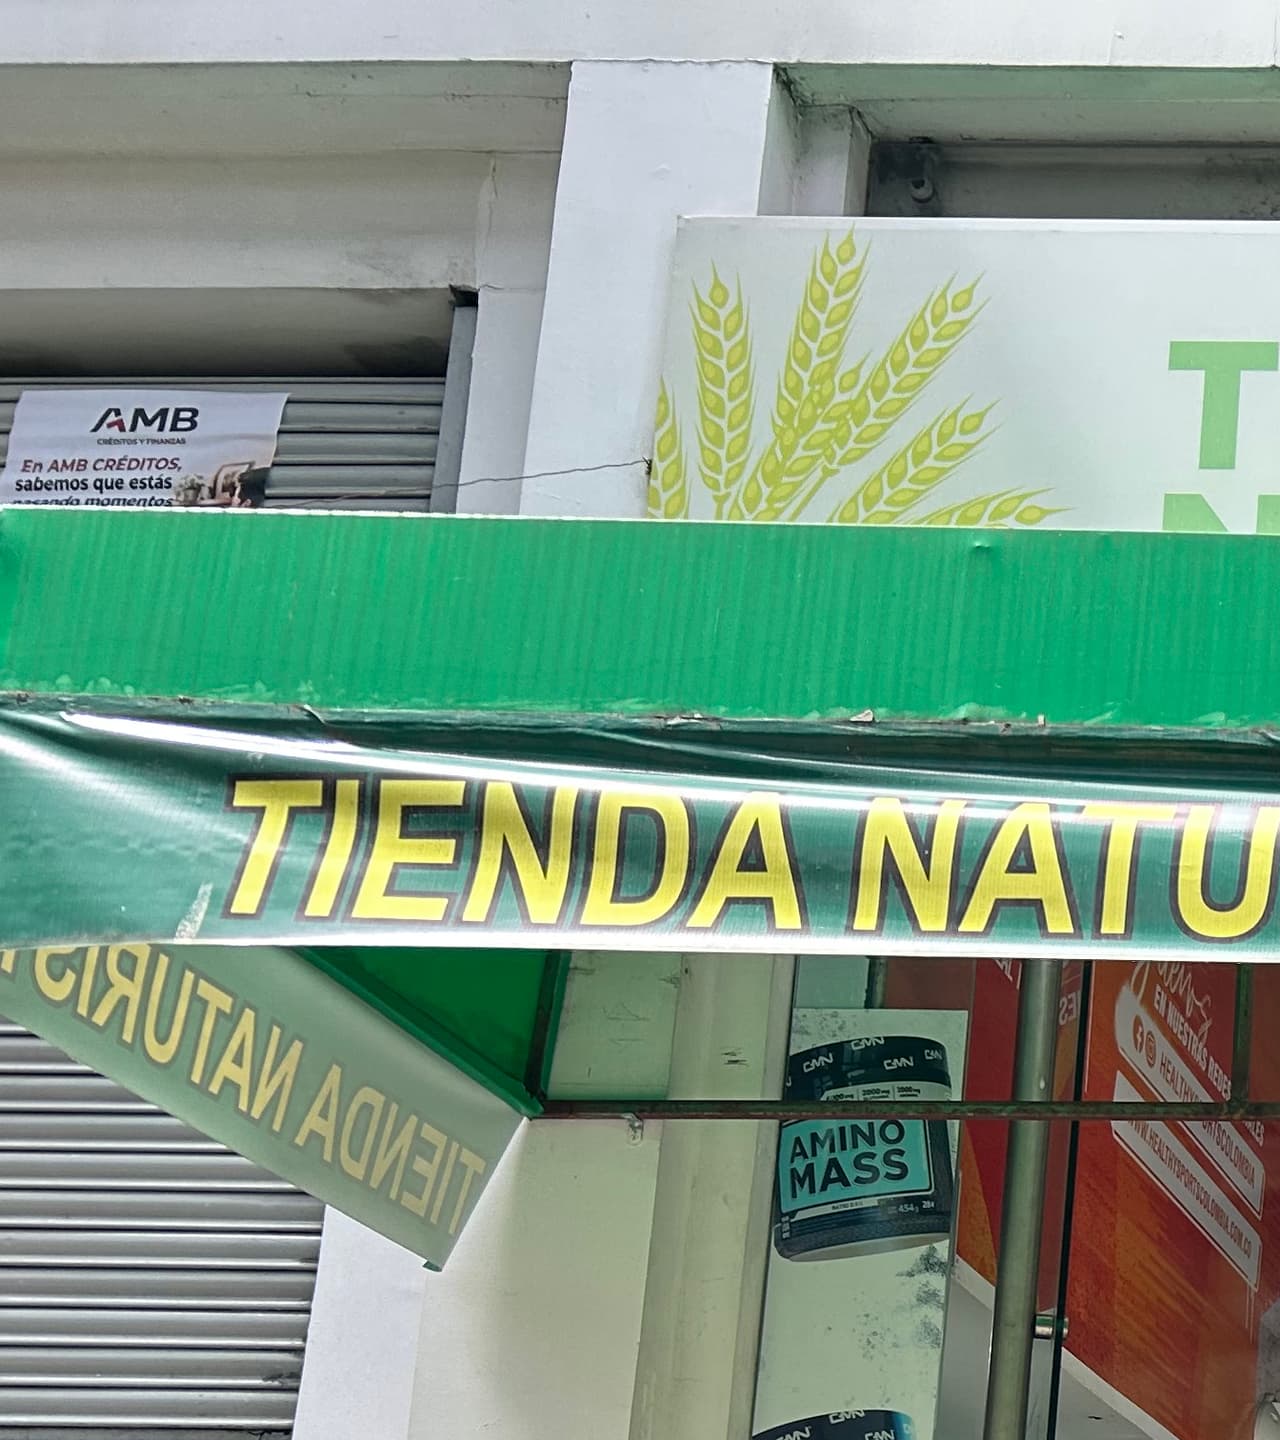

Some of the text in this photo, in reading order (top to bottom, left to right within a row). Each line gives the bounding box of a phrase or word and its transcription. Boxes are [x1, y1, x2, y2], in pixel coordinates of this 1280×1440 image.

[90, 407, 200, 433] AMB
[15, 473, 172, 497] sabemos que estás
[21, 454, 183, 473] En AMB CRÉDITOS,
[226, 773, 808, 932] TIENDA
[1208, 1056, 1232, 1101] REDES
[789, 1119, 906, 1164] AMINO
[789, 1148, 909, 1200] MASS
